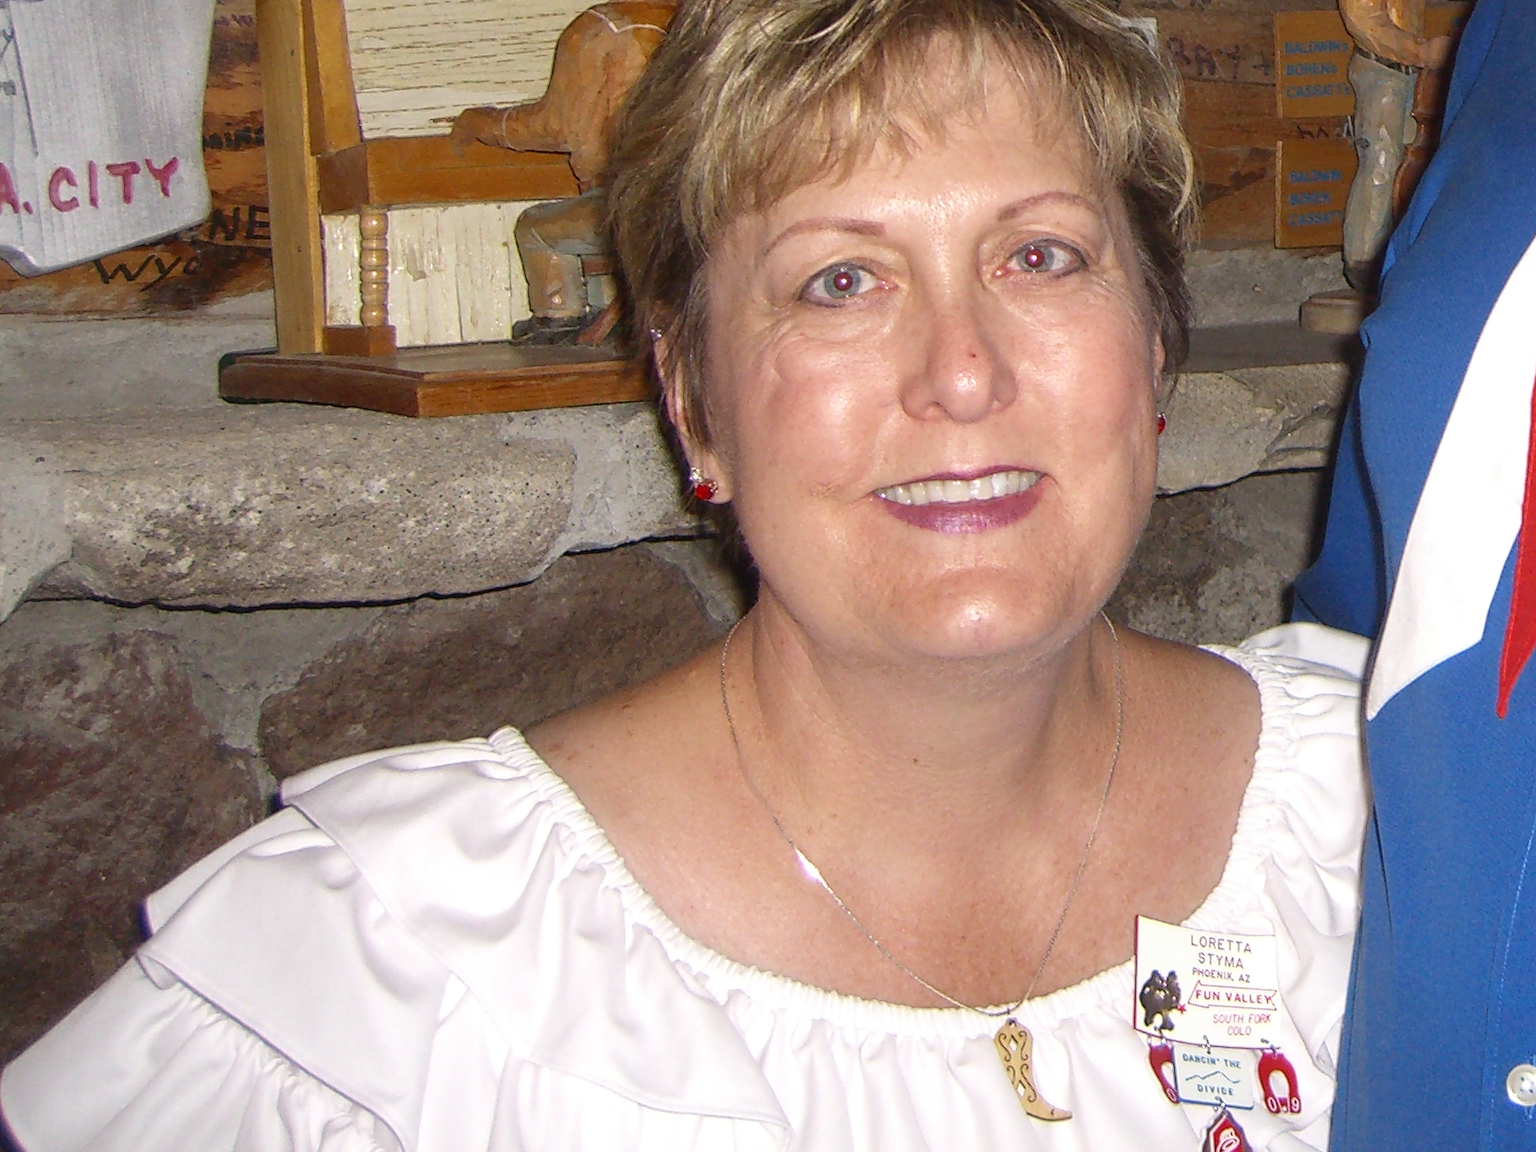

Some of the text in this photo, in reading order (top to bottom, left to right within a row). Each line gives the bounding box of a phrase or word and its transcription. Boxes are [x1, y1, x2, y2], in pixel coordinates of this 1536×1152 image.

[48, 156, 180, 212] CITY
[1190, 934, 1252, 954] LORETTA
[1197, 952, 1244, 970] STYMA
[1238, 974, 1251, 984] AZ
[1195, 989, 1273, 1005] FUN VALLEY
[1213, 1013, 1272, 1024] SOUTH FORK
[1227, 1025, 1252, 1036] COLO
[1197, 1083, 1235, 1097] DIVIDE
